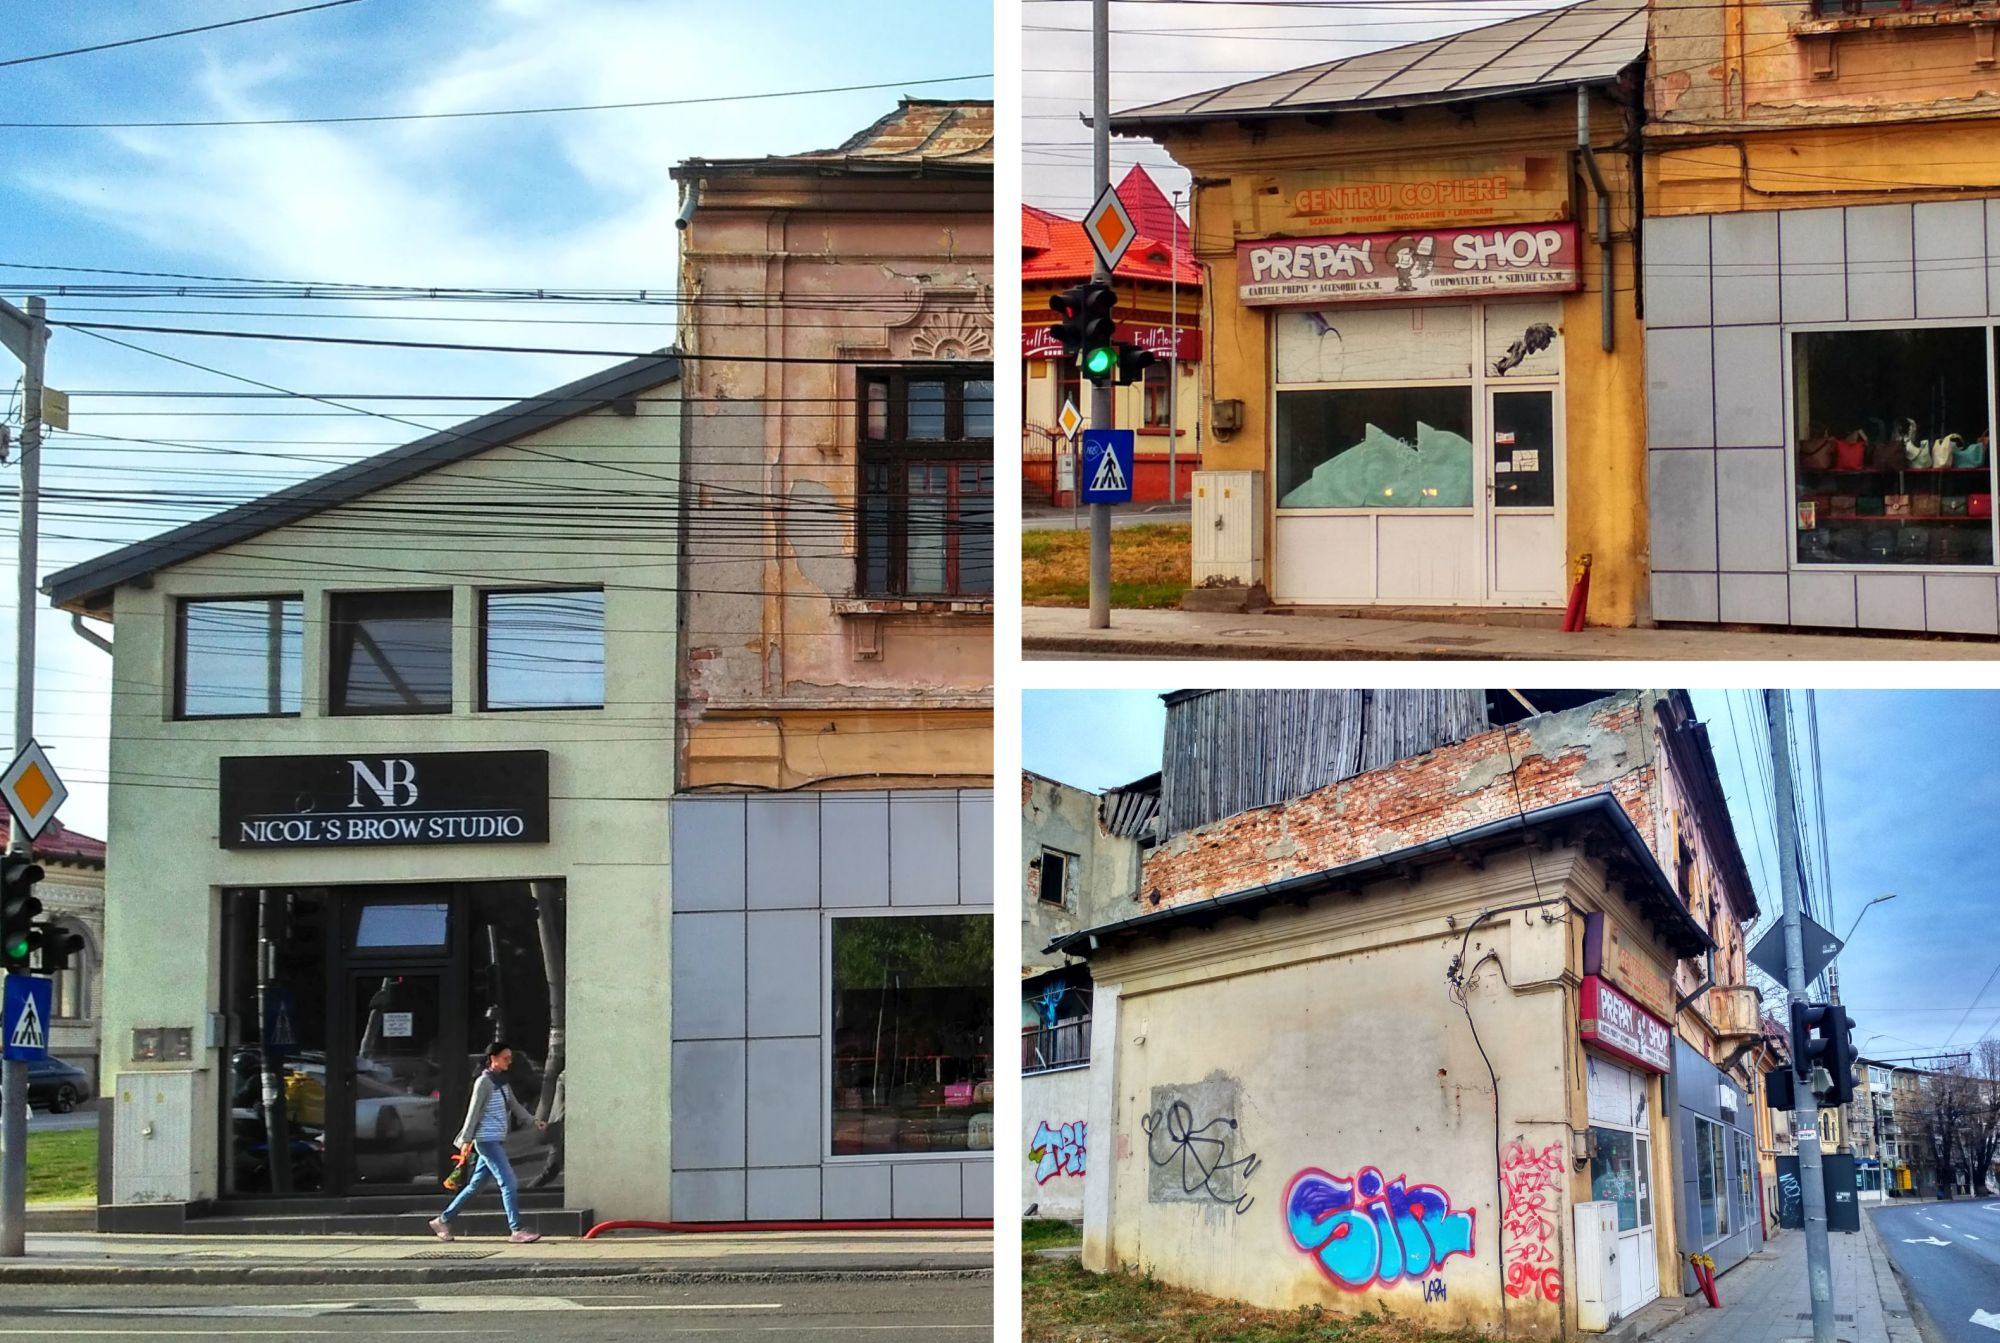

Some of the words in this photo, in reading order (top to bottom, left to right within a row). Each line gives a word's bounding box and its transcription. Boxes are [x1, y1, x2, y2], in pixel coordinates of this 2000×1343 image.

[1295, 185, 1393, 212] CENTRU
[1401, 177, 1508, 207] COPIERE
[1351, 214, 1387, 223] PRINTARE
[1249, 239, 1375, 282] PREPAY
[1452, 230, 1563, 271] SHOP
[1248, 286, 1280, 296] CARTELE
[1282, 285, 1309, 294] PREPAY
[1320, 282, 1357, 293] ACCESORII
[1430, 276, 1480, 287] COMPONENTE
[1505, 272, 1537, 283] SERVICE
[1134, 328, 1157, 348] Full
[347, 759, 418, 808] NB
[240, 819, 342, 842] NICOL'S
[346, 817, 425, 840] BROW
[428, 815, 524, 838] STUDIO
[1600, 987, 1634, 1033] PREPAY
[1648, 1019, 1668, 1053] SHOP
